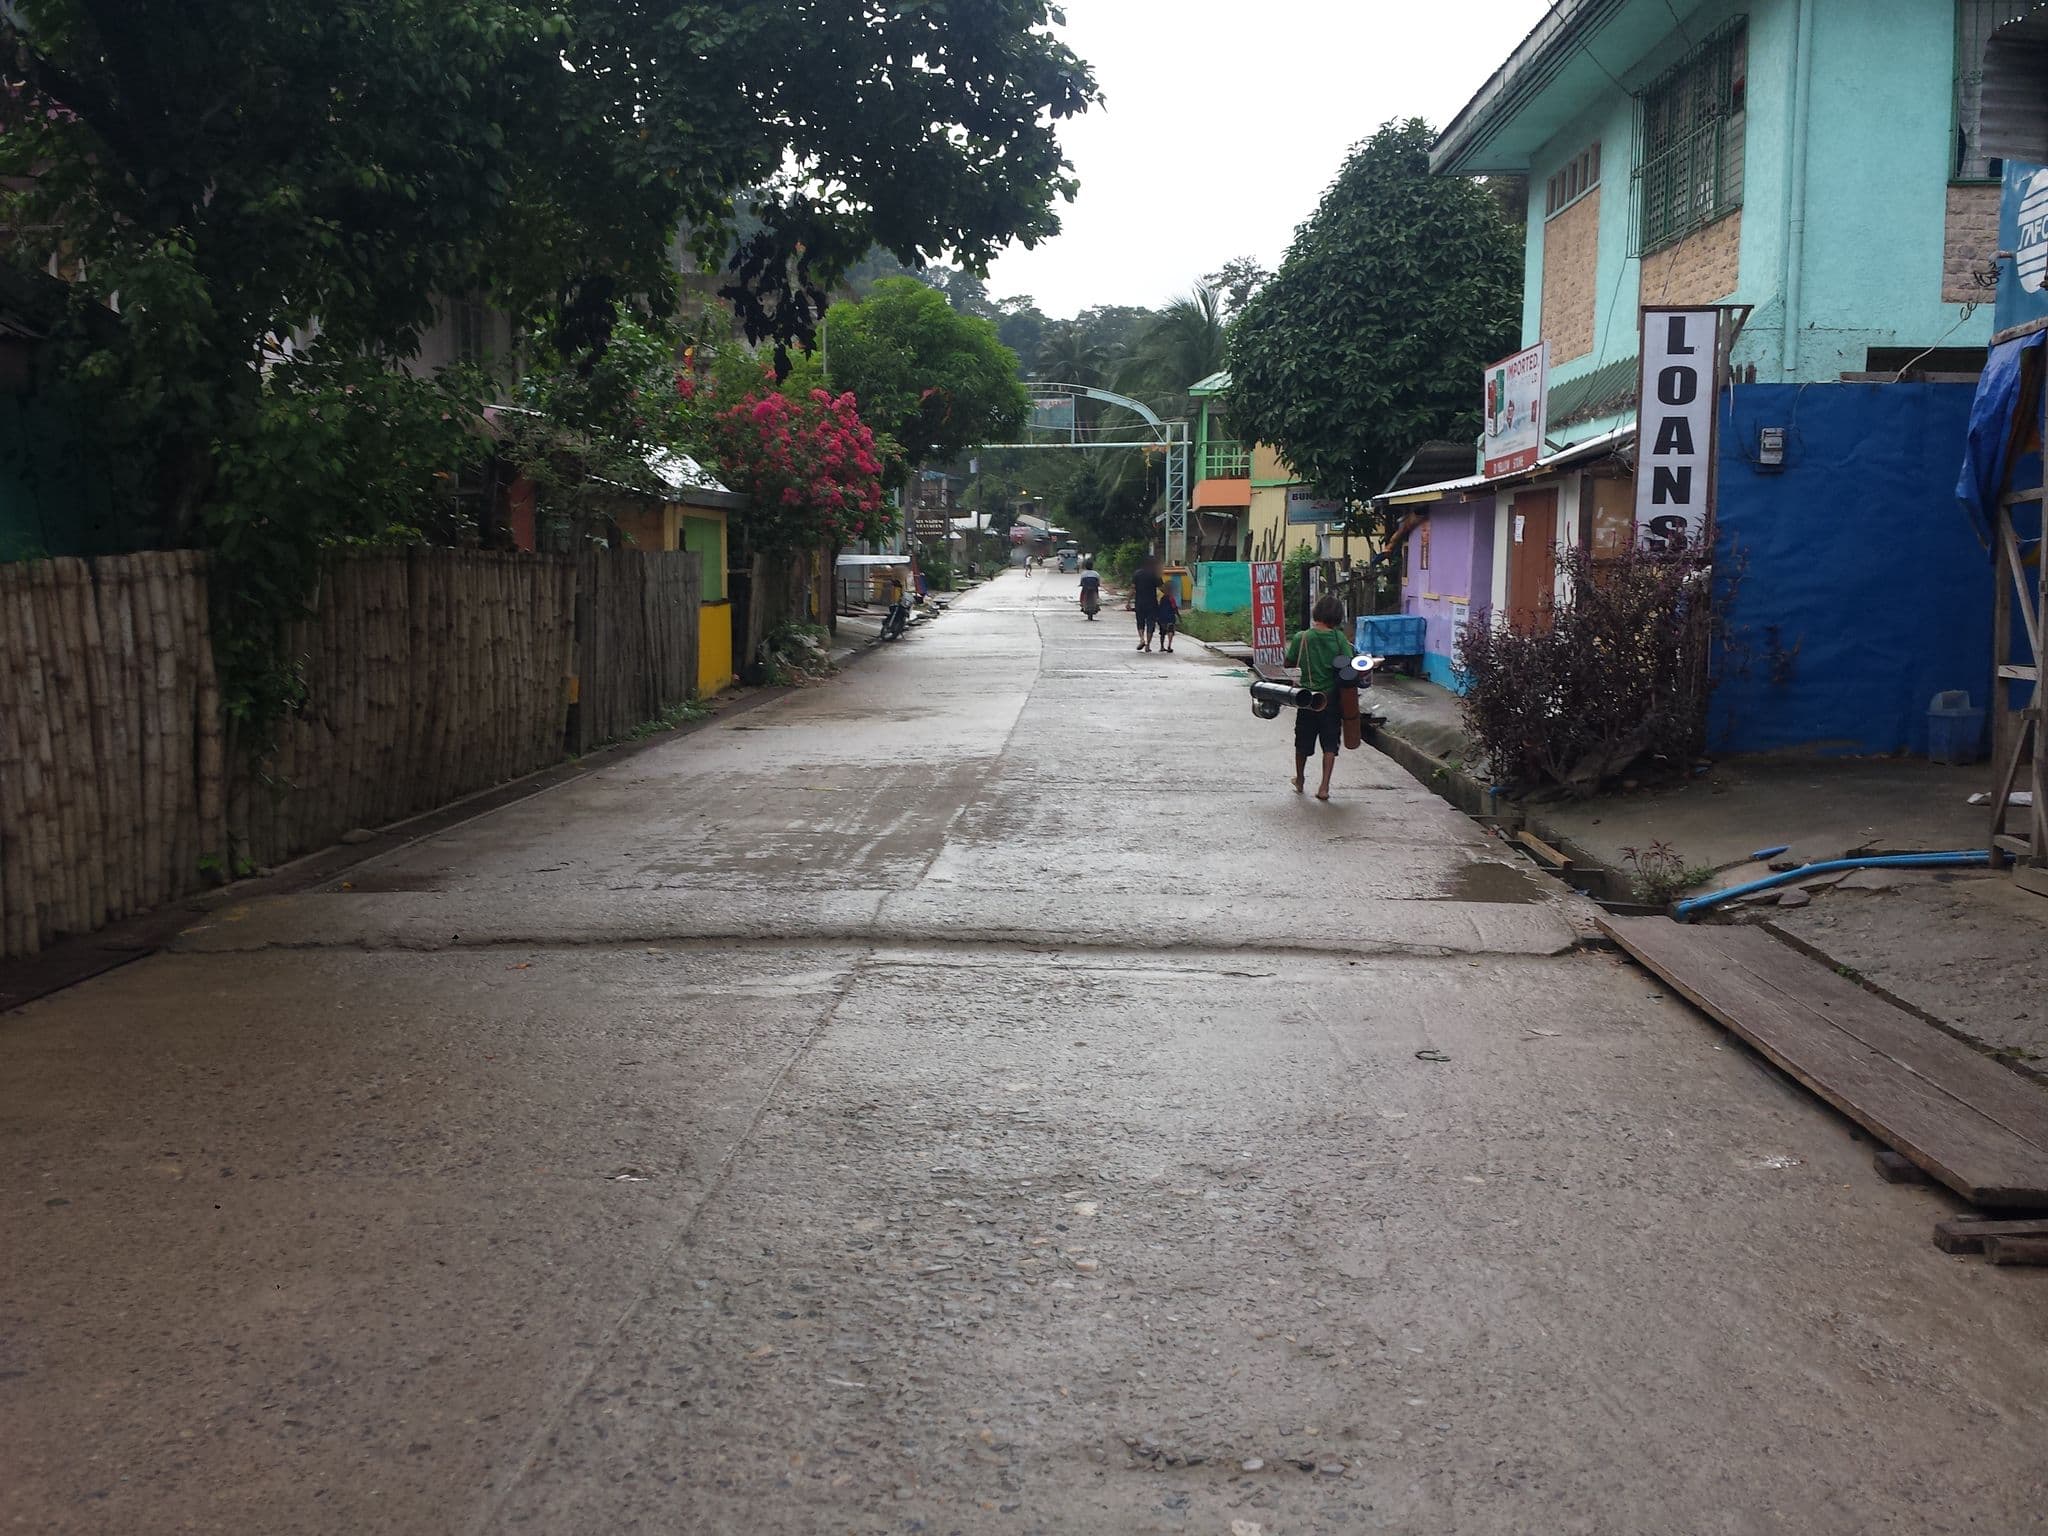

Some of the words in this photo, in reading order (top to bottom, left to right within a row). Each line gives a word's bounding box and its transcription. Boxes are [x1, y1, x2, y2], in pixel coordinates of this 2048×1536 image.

[1650, 316, 1697, 552] LOANS
[1259, 585, 1275, 604] BIKE
[1261, 606, 1275, 625] AND
[1257, 627, 1280, 646] KAYAK
[1254, 647, 1285, 666] RENTALS
